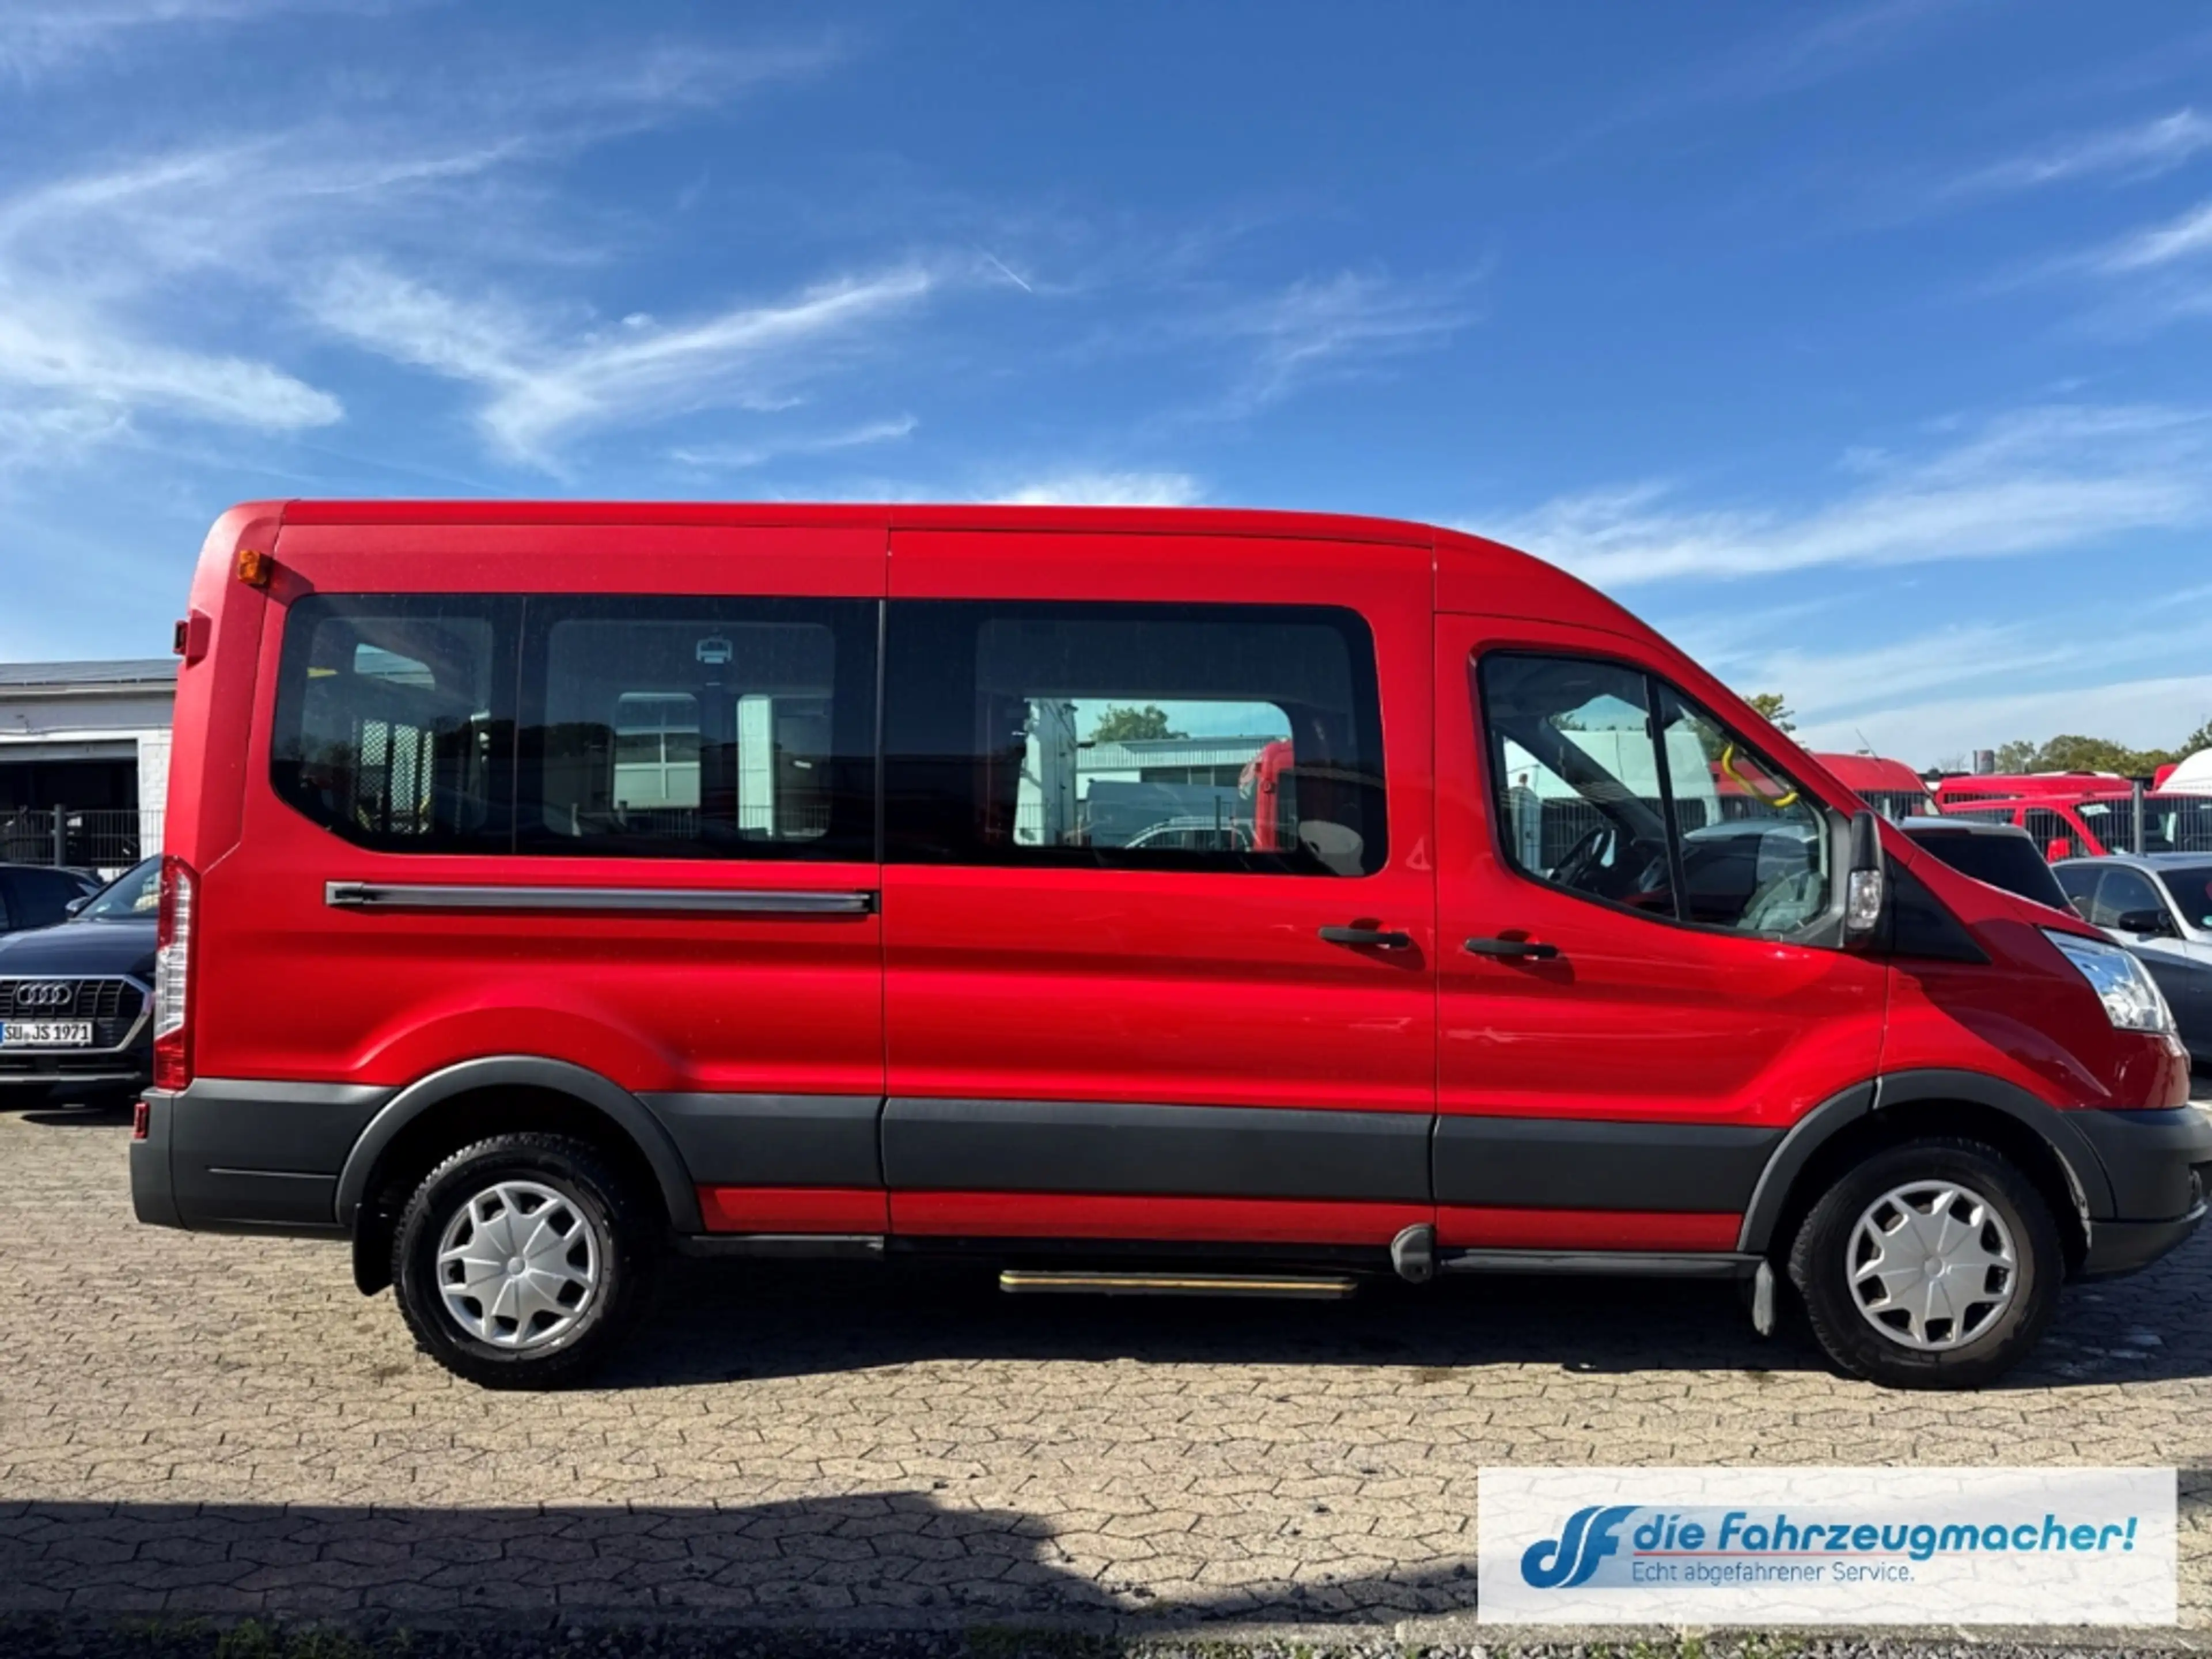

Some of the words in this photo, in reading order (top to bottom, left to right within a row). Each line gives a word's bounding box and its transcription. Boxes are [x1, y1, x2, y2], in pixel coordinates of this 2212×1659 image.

[5, 1025, 22, 1040] SU
[32, 1025, 50, 1040] JS
[54, 1025, 89, 1040] 1971
